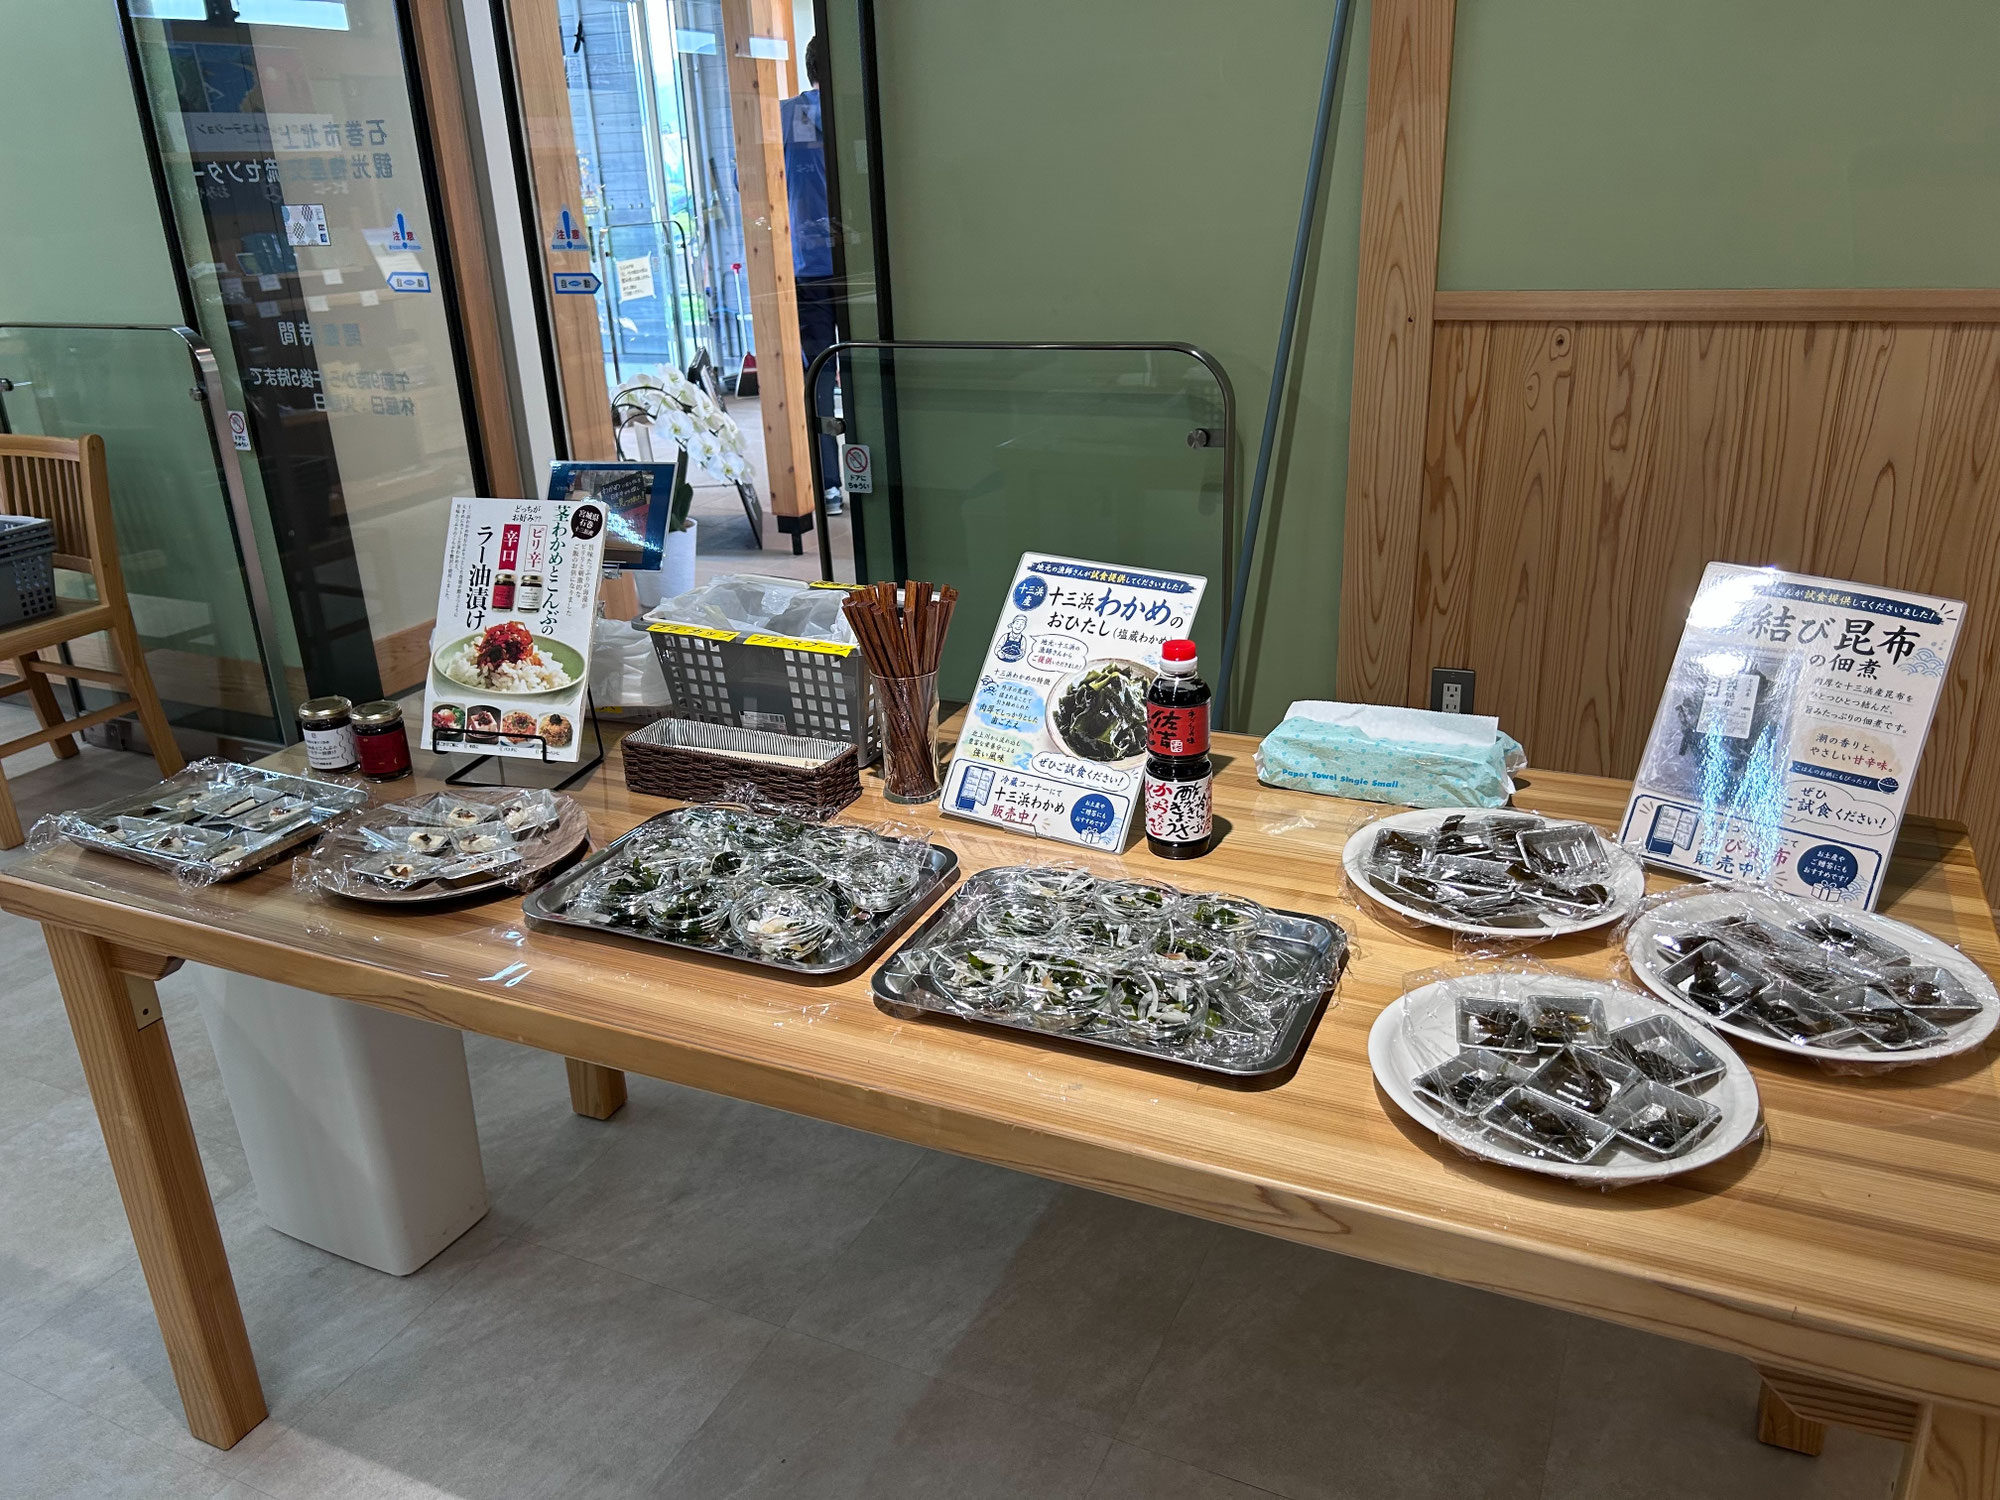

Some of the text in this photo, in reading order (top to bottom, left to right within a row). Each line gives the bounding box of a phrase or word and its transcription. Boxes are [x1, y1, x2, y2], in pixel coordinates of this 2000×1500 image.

[515, 505, 541, 513] どっちが
[579, 518, 594, 529] 石巻
[502, 529, 519, 563] 辛口
[529, 527, 544, 569] ピリ辛
[466, 525, 494, 631] ラー油漬け
[542, 504, 571, 635] 茎わかめとこんぶの
[1036, 562, 1184, 592] 地元の漁師さんが試食提供してくださいました!
[1018, 582, 1045, 597] 十三浜
[1022, 594, 1033, 607] 産
[1049, 586, 1184, 629] 十三浜わかめの
[1777, 584, 1936, 621] さんが試食提供してくださいました!
[1748, 603, 1921, 665] 結び昆布
[1038, 646, 1073, 659] 漁師さんから
[994, 668, 1051, 687] 十三浜わかめの特徴
[1809, 653, 1882, 680] の佃煮
[1814, 677, 1914, 703] 肉厚な十三浜産昆布を
[978, 702, 1039, 724] 肉厚でしっかりとした
[1810, 691, 1894, 715] ひとつひとつ結んだ、
[990, 716, 1019, 729] 歯ごたえ
[1150, 710, 1183, 749] 佐吉
[1805, 705, 1907, 734] 旨みたっぷりの佃煮です。
[968, 737, 1016, 754] 豊富な栄養分による
[971, 730, 1021, 747] 北上川から流れ込む
[1815, 733, 1875, 754] 潮の香りと、
[972, 747, 1005, 763] 強い風味
[1810, 746, 1893, 773] やさしい甘辛味。
[1038, 757, 1124, 787] ぜひご試食ください!
[1282, 768, 1399, 788] Paper Towel Single Small
[1794, 764, 1872, 787] ごはんのお供にもぴったり!
[1000, 774, 1064, 798] 冷蔵コーナーにて
[1801, 787, 1828, 799] ぜひ
[994, 785, 1066, 816] 十三浜わかめ
[1084, 799, 1106, 810] お土産や
[991, 803, 1038, 825] 販売中!
[1075, 815, 1108, 829] おすすめです!
[1080, 807, 1107, 820] ご贈答にも
[1784, 797, 1886, 829] ご試食ください!
[1810, 858, 1848, 873] ご贈答にも
[1816, 850, 1846, 862] お土産や
[1803, 866, 1850, 883] おすすめです!
